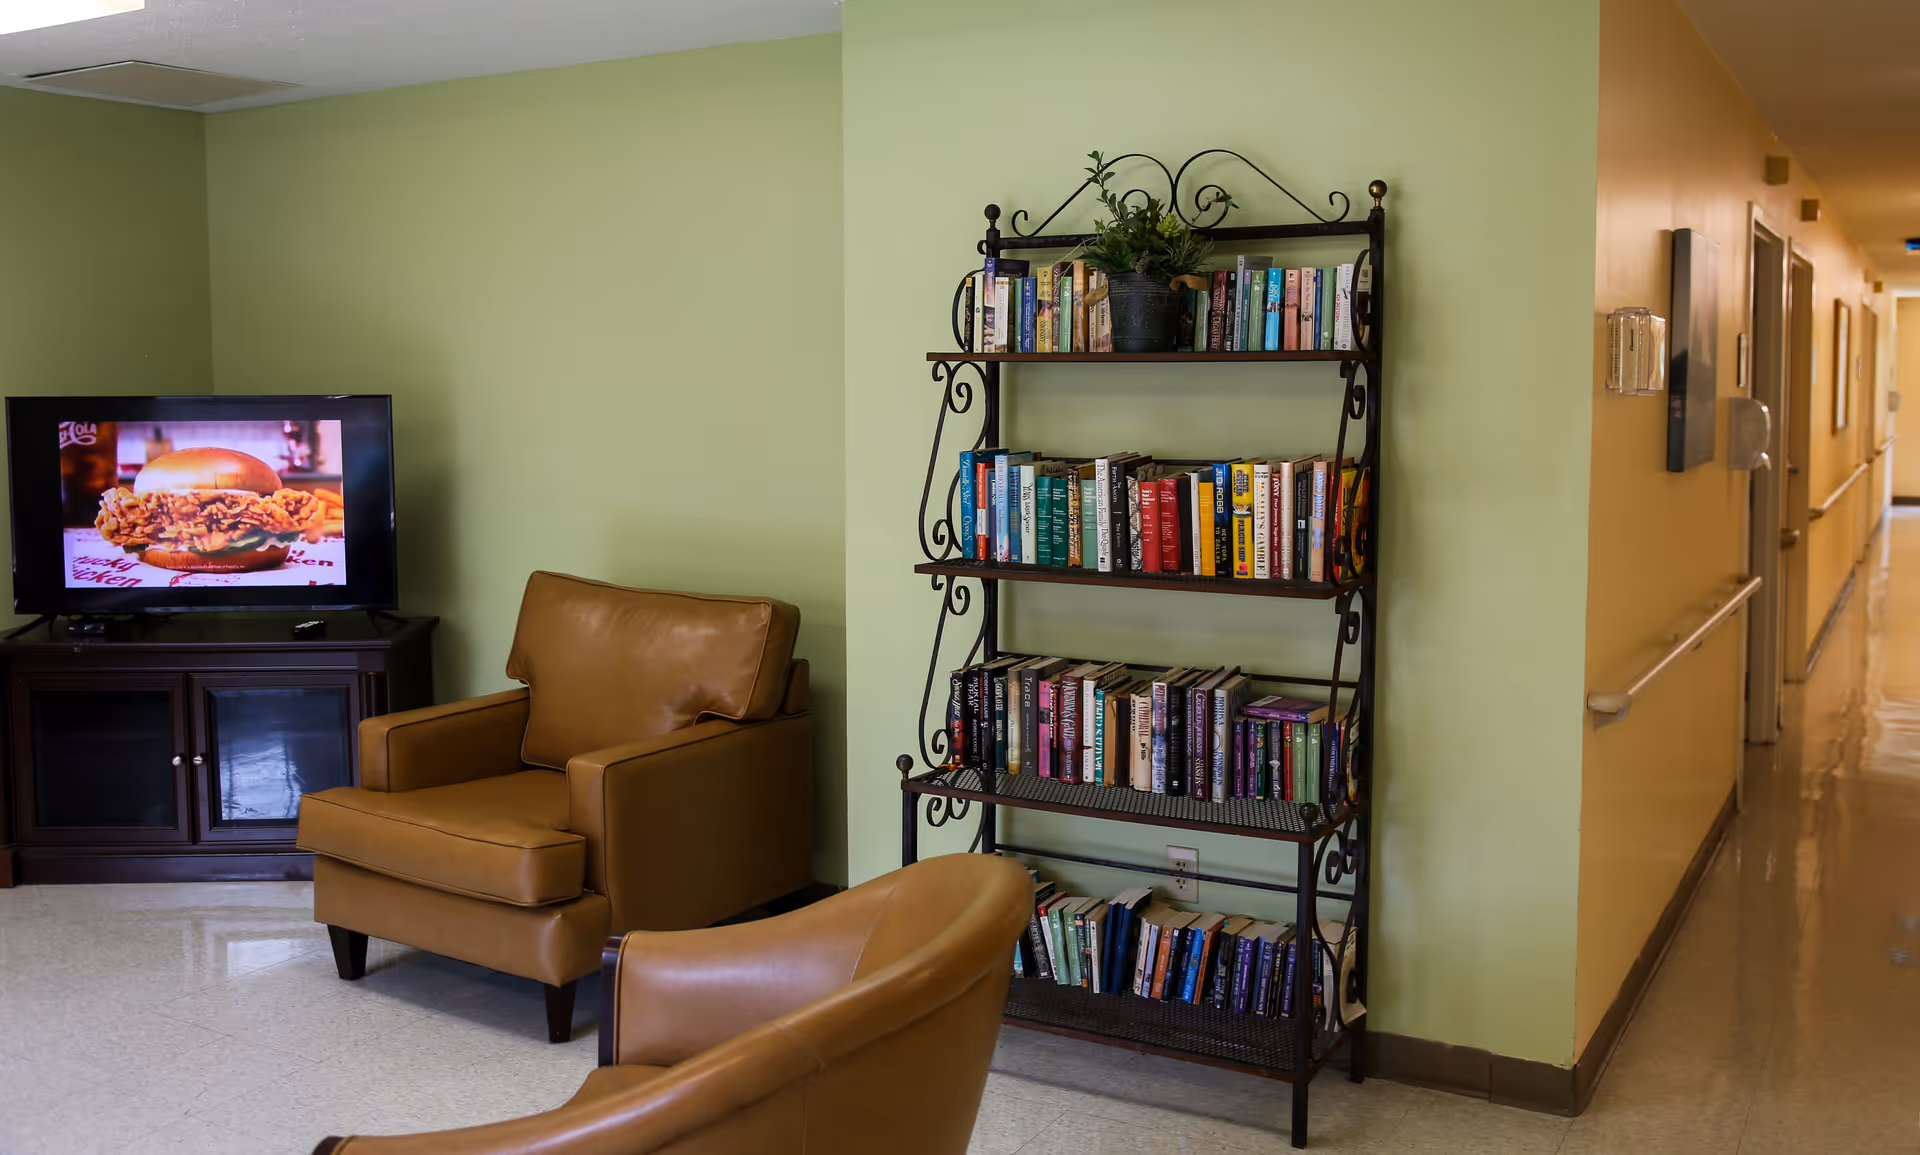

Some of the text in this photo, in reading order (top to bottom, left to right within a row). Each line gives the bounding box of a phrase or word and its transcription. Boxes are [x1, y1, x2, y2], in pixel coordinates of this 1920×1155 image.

[1097, 464, 1107, 528] The American Family
[1216, 487, 1224, 514] ROBB
[1256, 532, 1265, 571] GAMBLE
[1024, 677, 1033, 708] Trace
